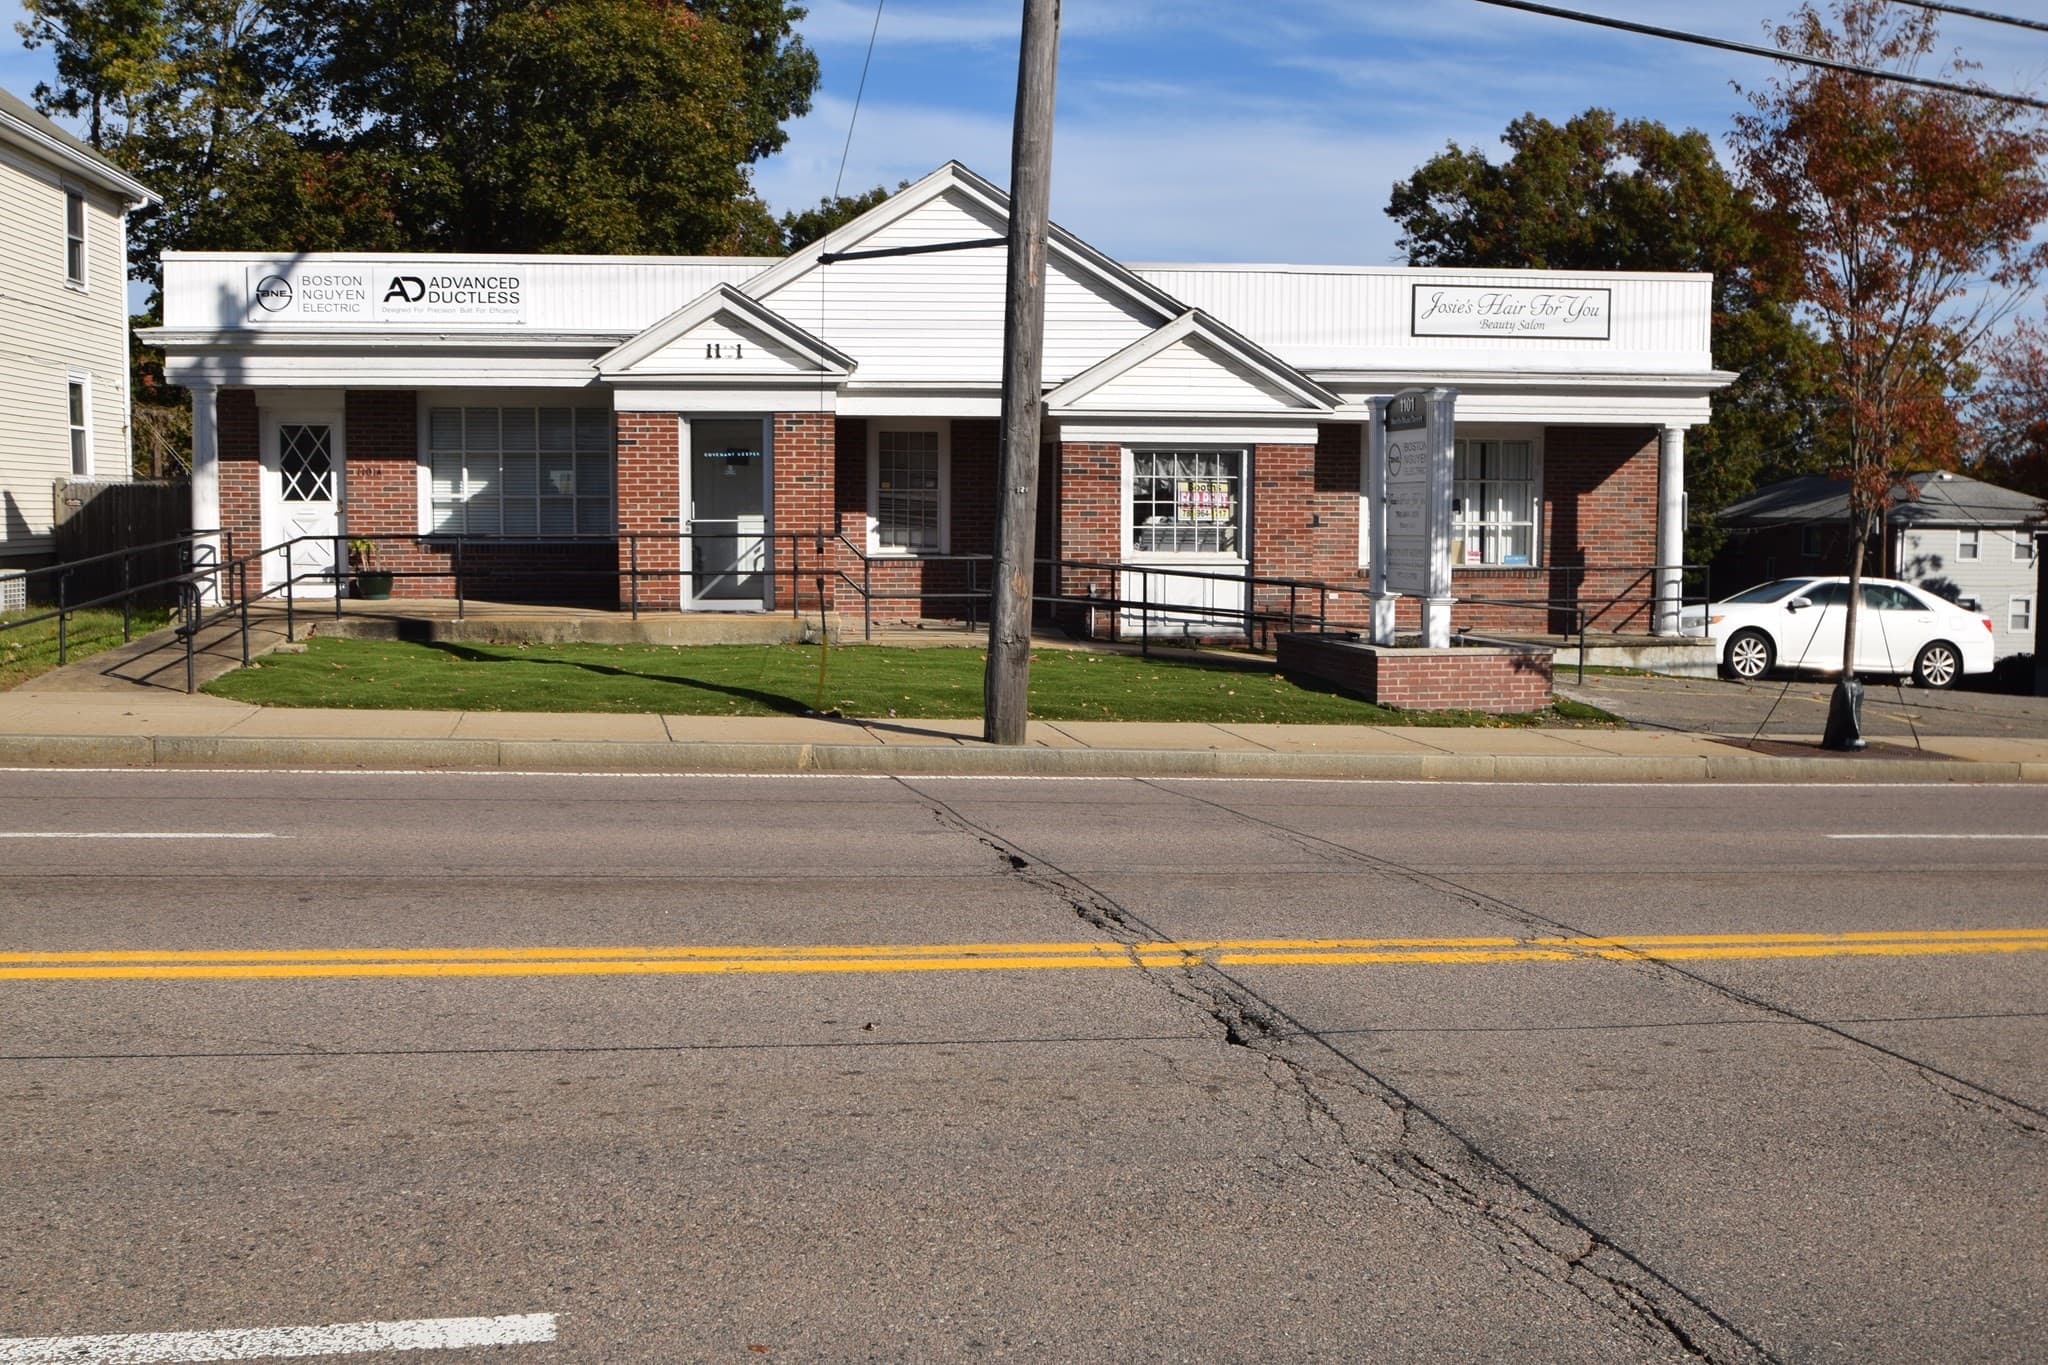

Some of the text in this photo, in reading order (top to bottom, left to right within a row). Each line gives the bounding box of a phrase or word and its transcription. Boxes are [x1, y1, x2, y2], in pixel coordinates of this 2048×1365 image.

[302, 275, 362, 287] BOSTON
[428, 276, 520, 290] ADVANCED
[302, 289, 366, 301] NGUYEN
[428, 291, 521, 305] DUCTLESS
[302, 303, 361, 313] ELECTRIC
[1420, 291, 1601, 324] Josie's Hair For You
[1479, 318, 1546, 334] Beauty Salon
[1400, 397, 1415, 413] 1101
